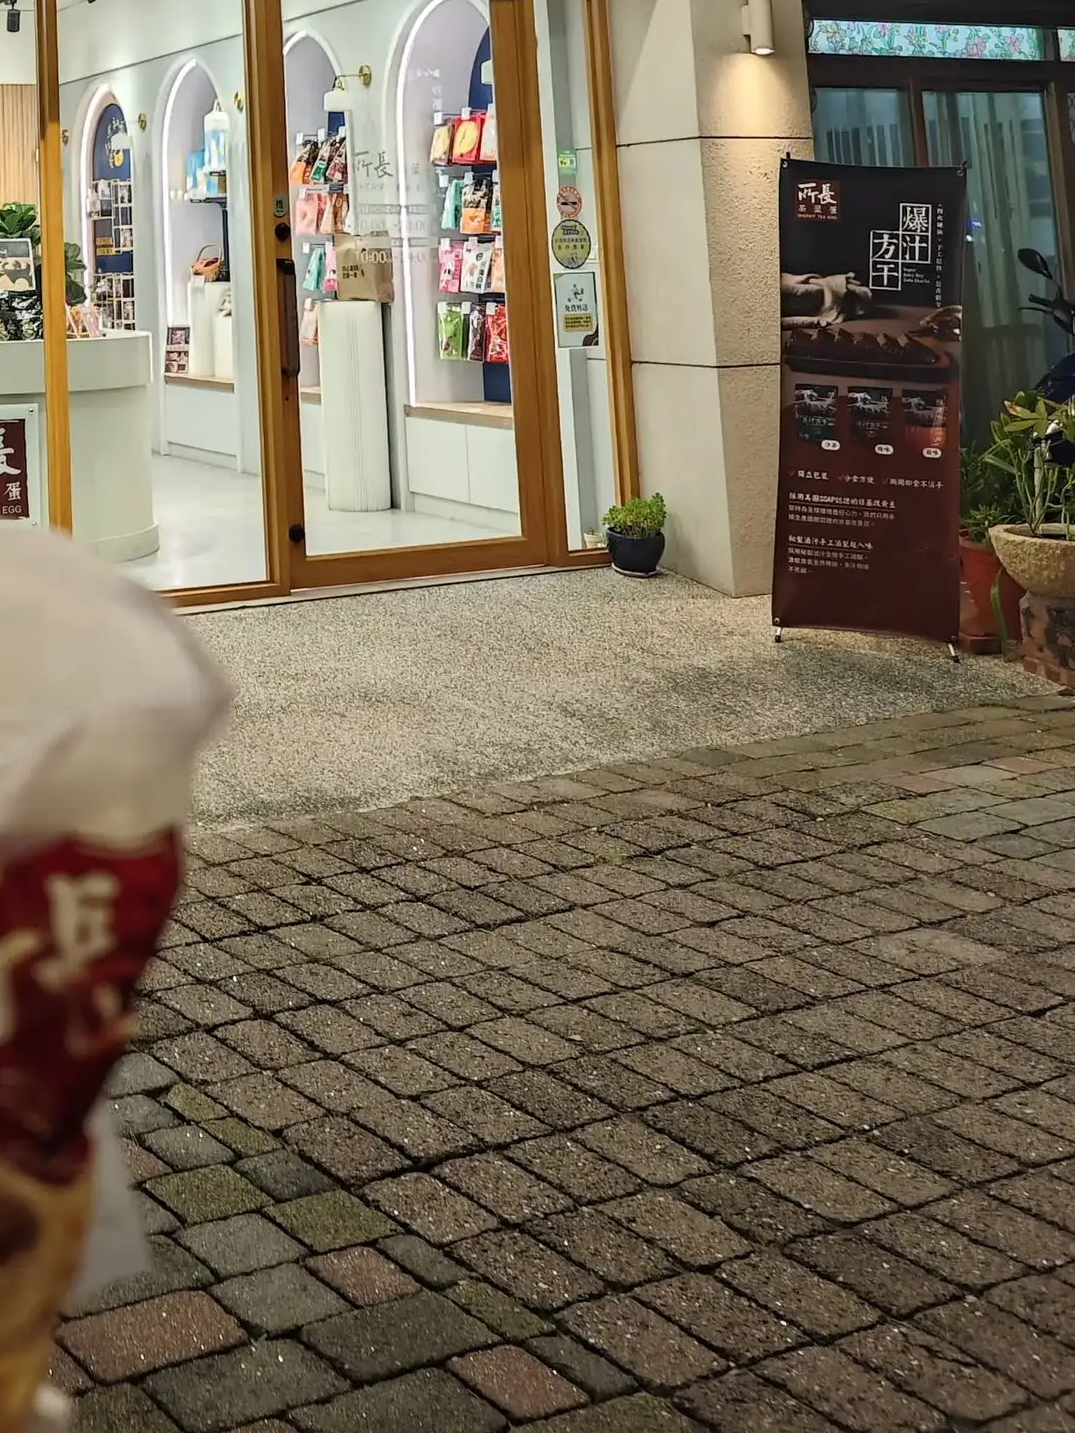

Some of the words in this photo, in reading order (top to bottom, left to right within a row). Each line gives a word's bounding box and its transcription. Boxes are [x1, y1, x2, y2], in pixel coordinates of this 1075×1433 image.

[798, 182, 837, 205] 所長
[901, 206, 929, 261] 爆汁
[2, 505, 22, 514] EGG
